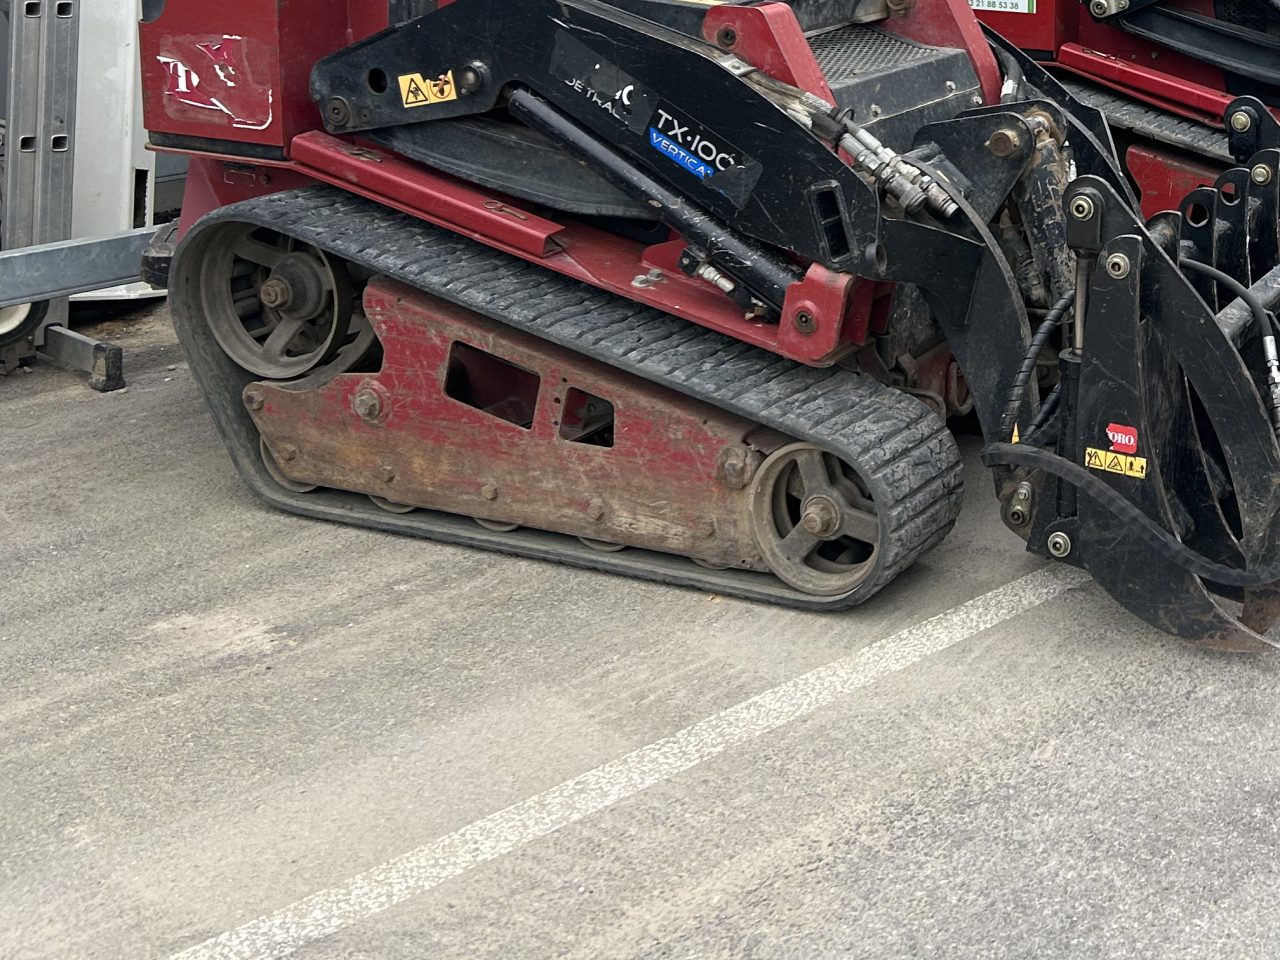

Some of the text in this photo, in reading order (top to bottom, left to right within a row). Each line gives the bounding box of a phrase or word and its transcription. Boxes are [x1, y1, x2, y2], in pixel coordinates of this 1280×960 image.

[987, 0, 996, 8] 88
[999, 1, 1007, 9] 53
[651, 131, 713, 177] VERTICA
[1107, 431, 1135, 446] ORO
